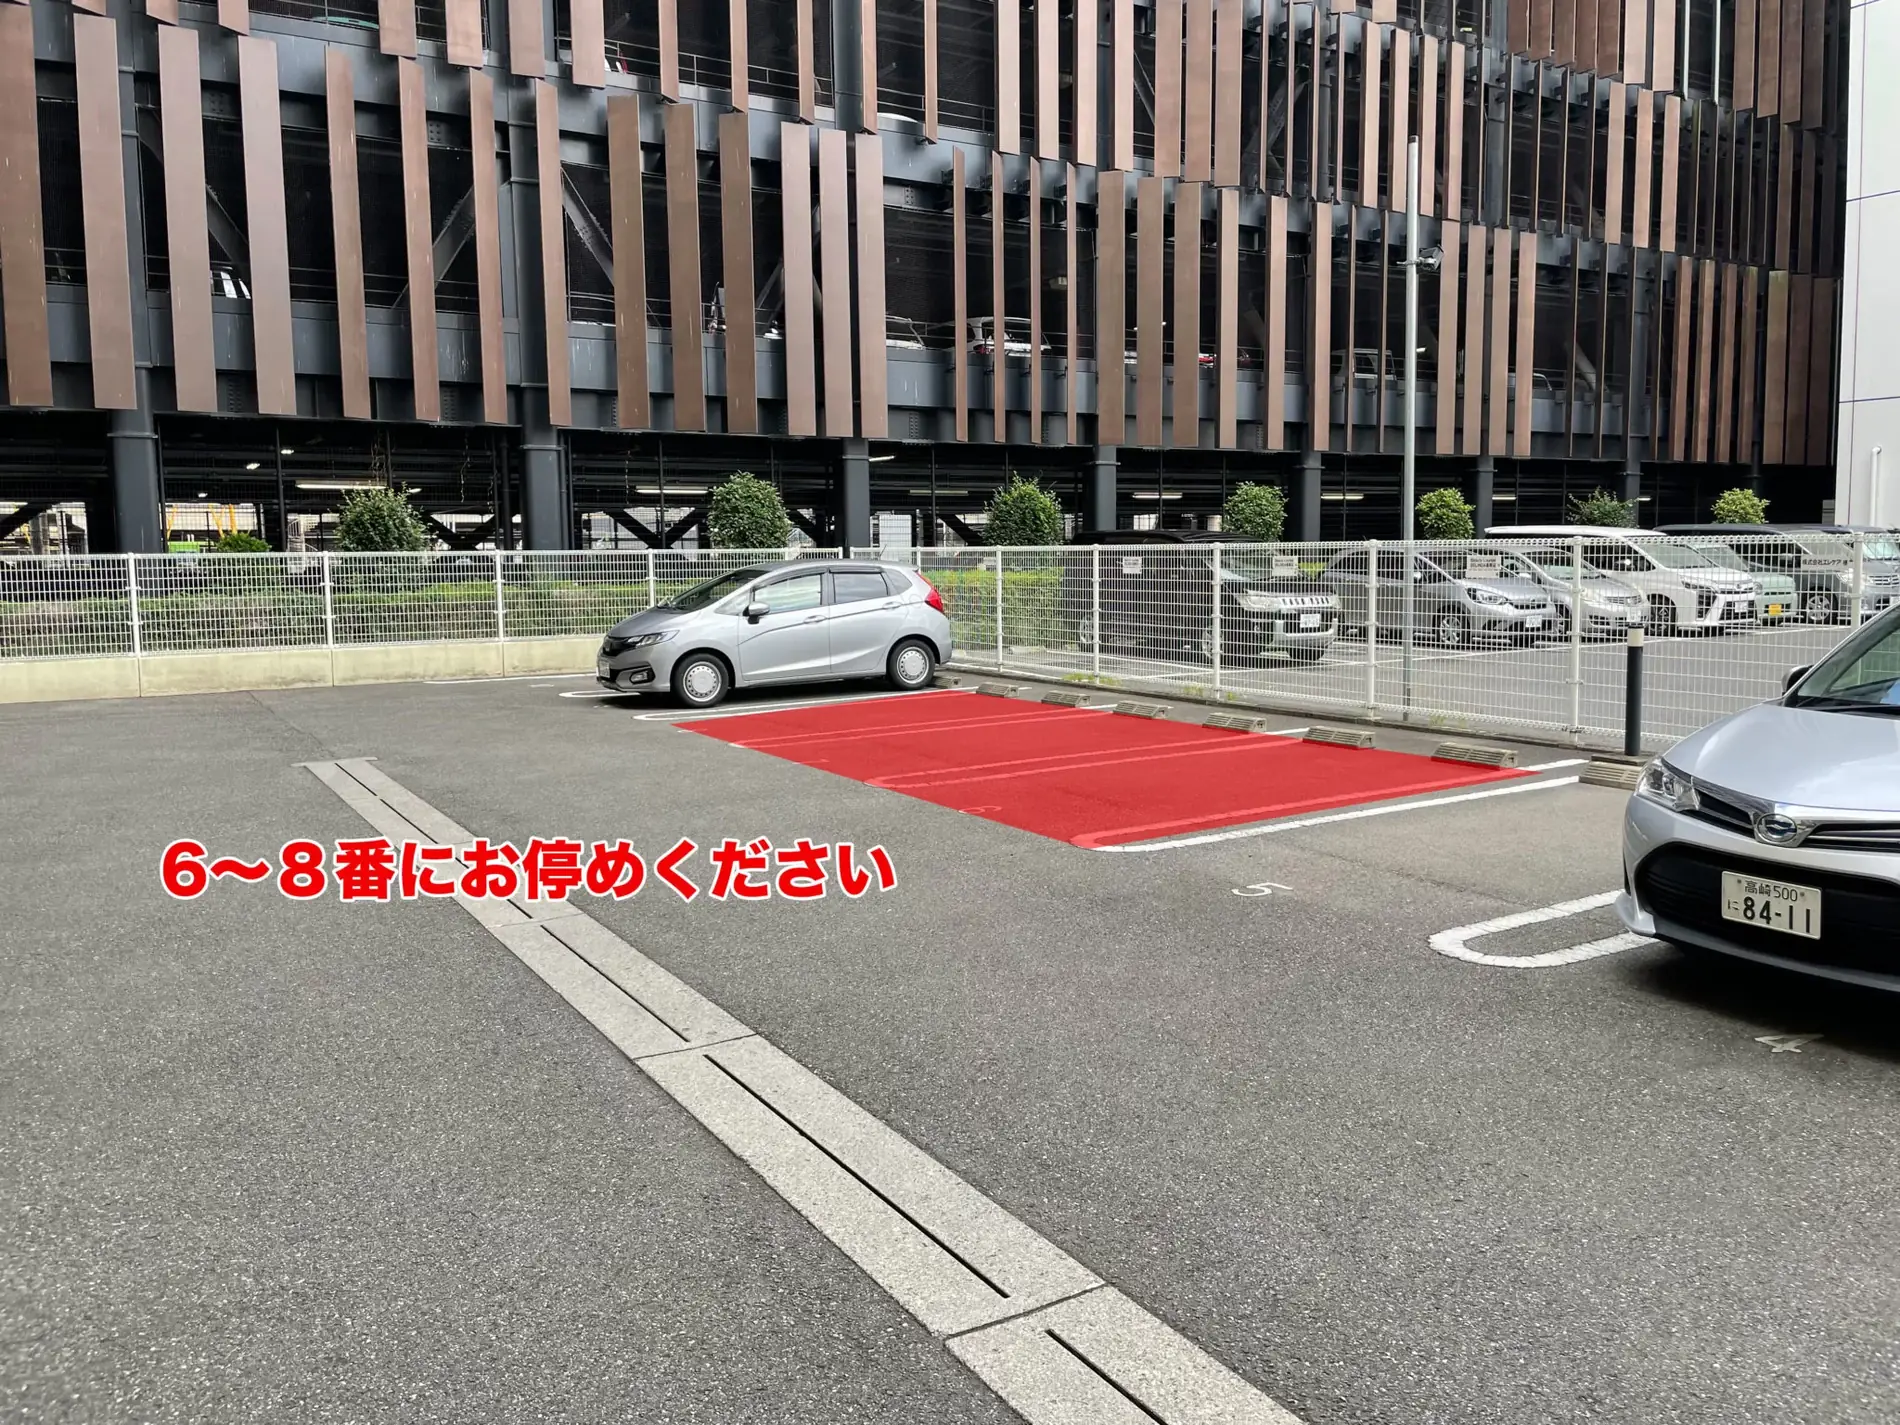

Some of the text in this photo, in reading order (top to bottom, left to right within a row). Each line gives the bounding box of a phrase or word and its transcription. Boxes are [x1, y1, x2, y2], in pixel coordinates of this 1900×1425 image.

[1231, 882, 1294, 897] 5
[1743, 896, 1811, 934] 84-11
[1754, 1034, 1824, 1053] 4
